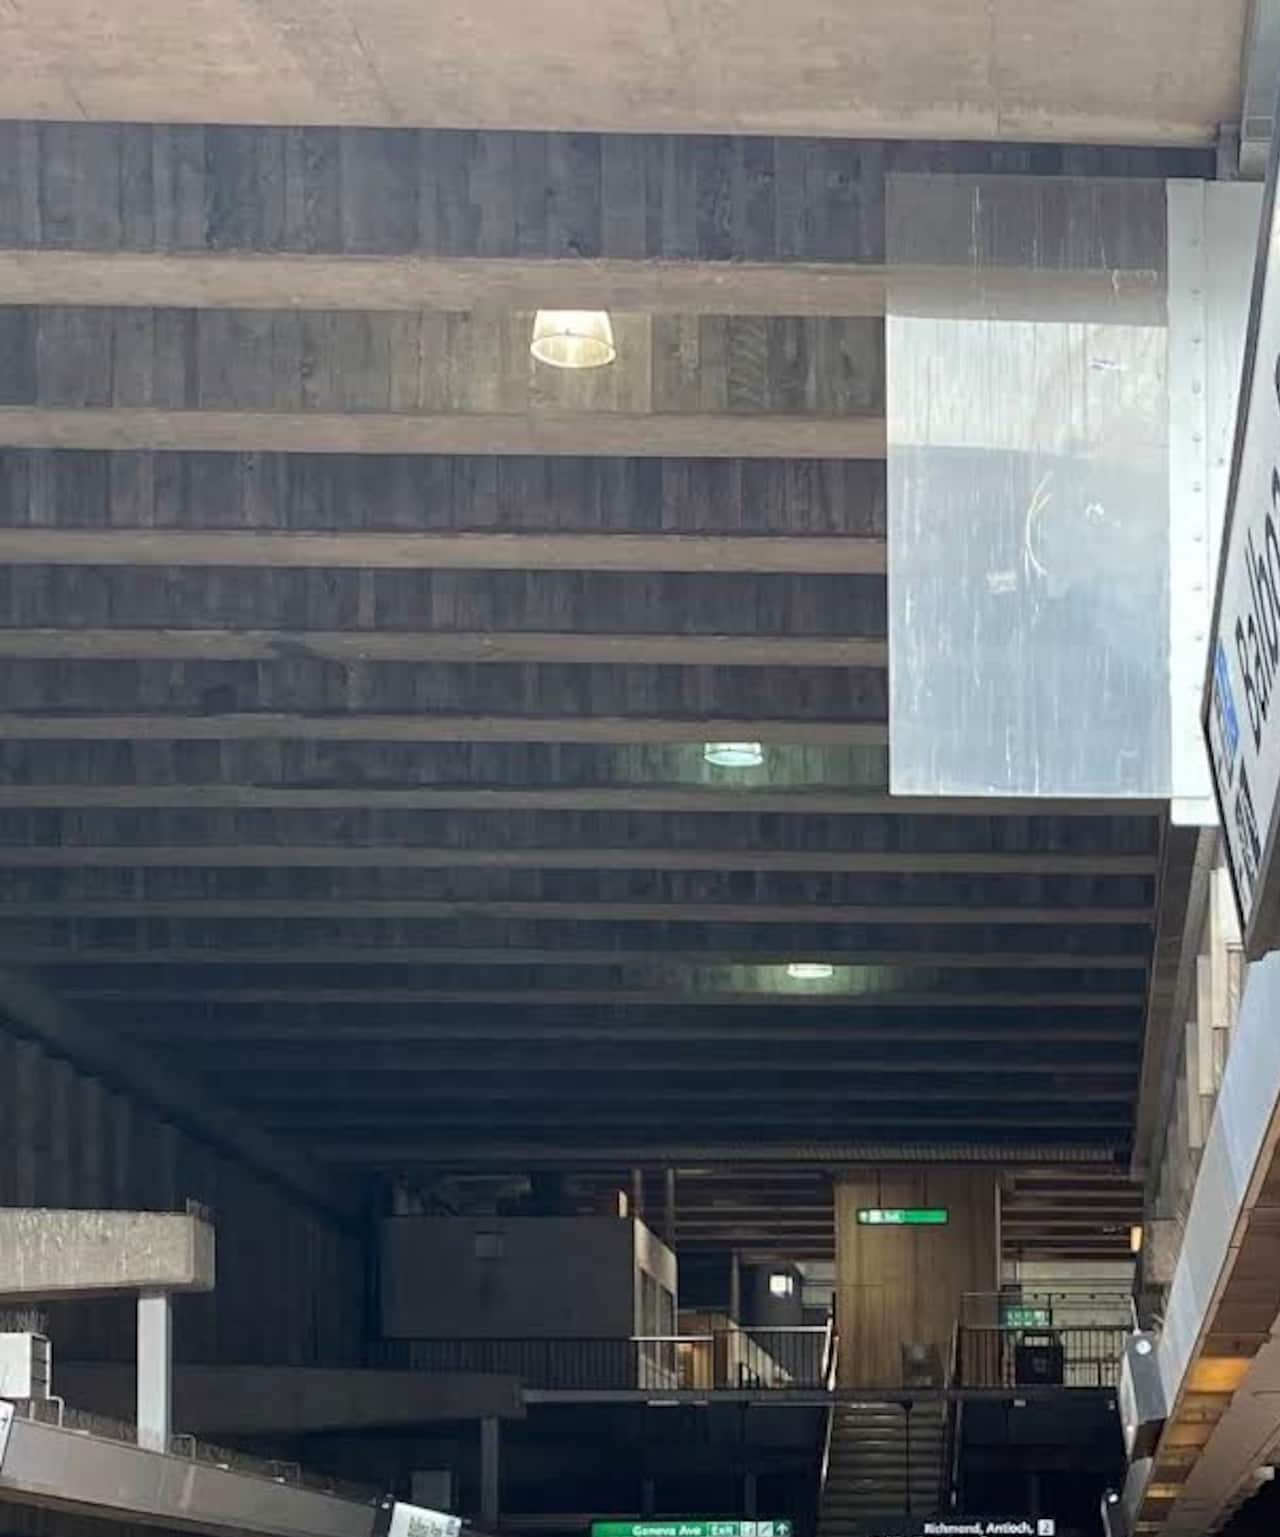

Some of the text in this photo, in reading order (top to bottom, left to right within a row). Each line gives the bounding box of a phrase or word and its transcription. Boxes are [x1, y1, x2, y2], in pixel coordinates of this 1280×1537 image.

[631, 1523, 735, 1536] Geneva Ave Exit
[924, 1522, 984, 1536] Richmond,
[986, 1521, 1034, 1535] Antioch,
